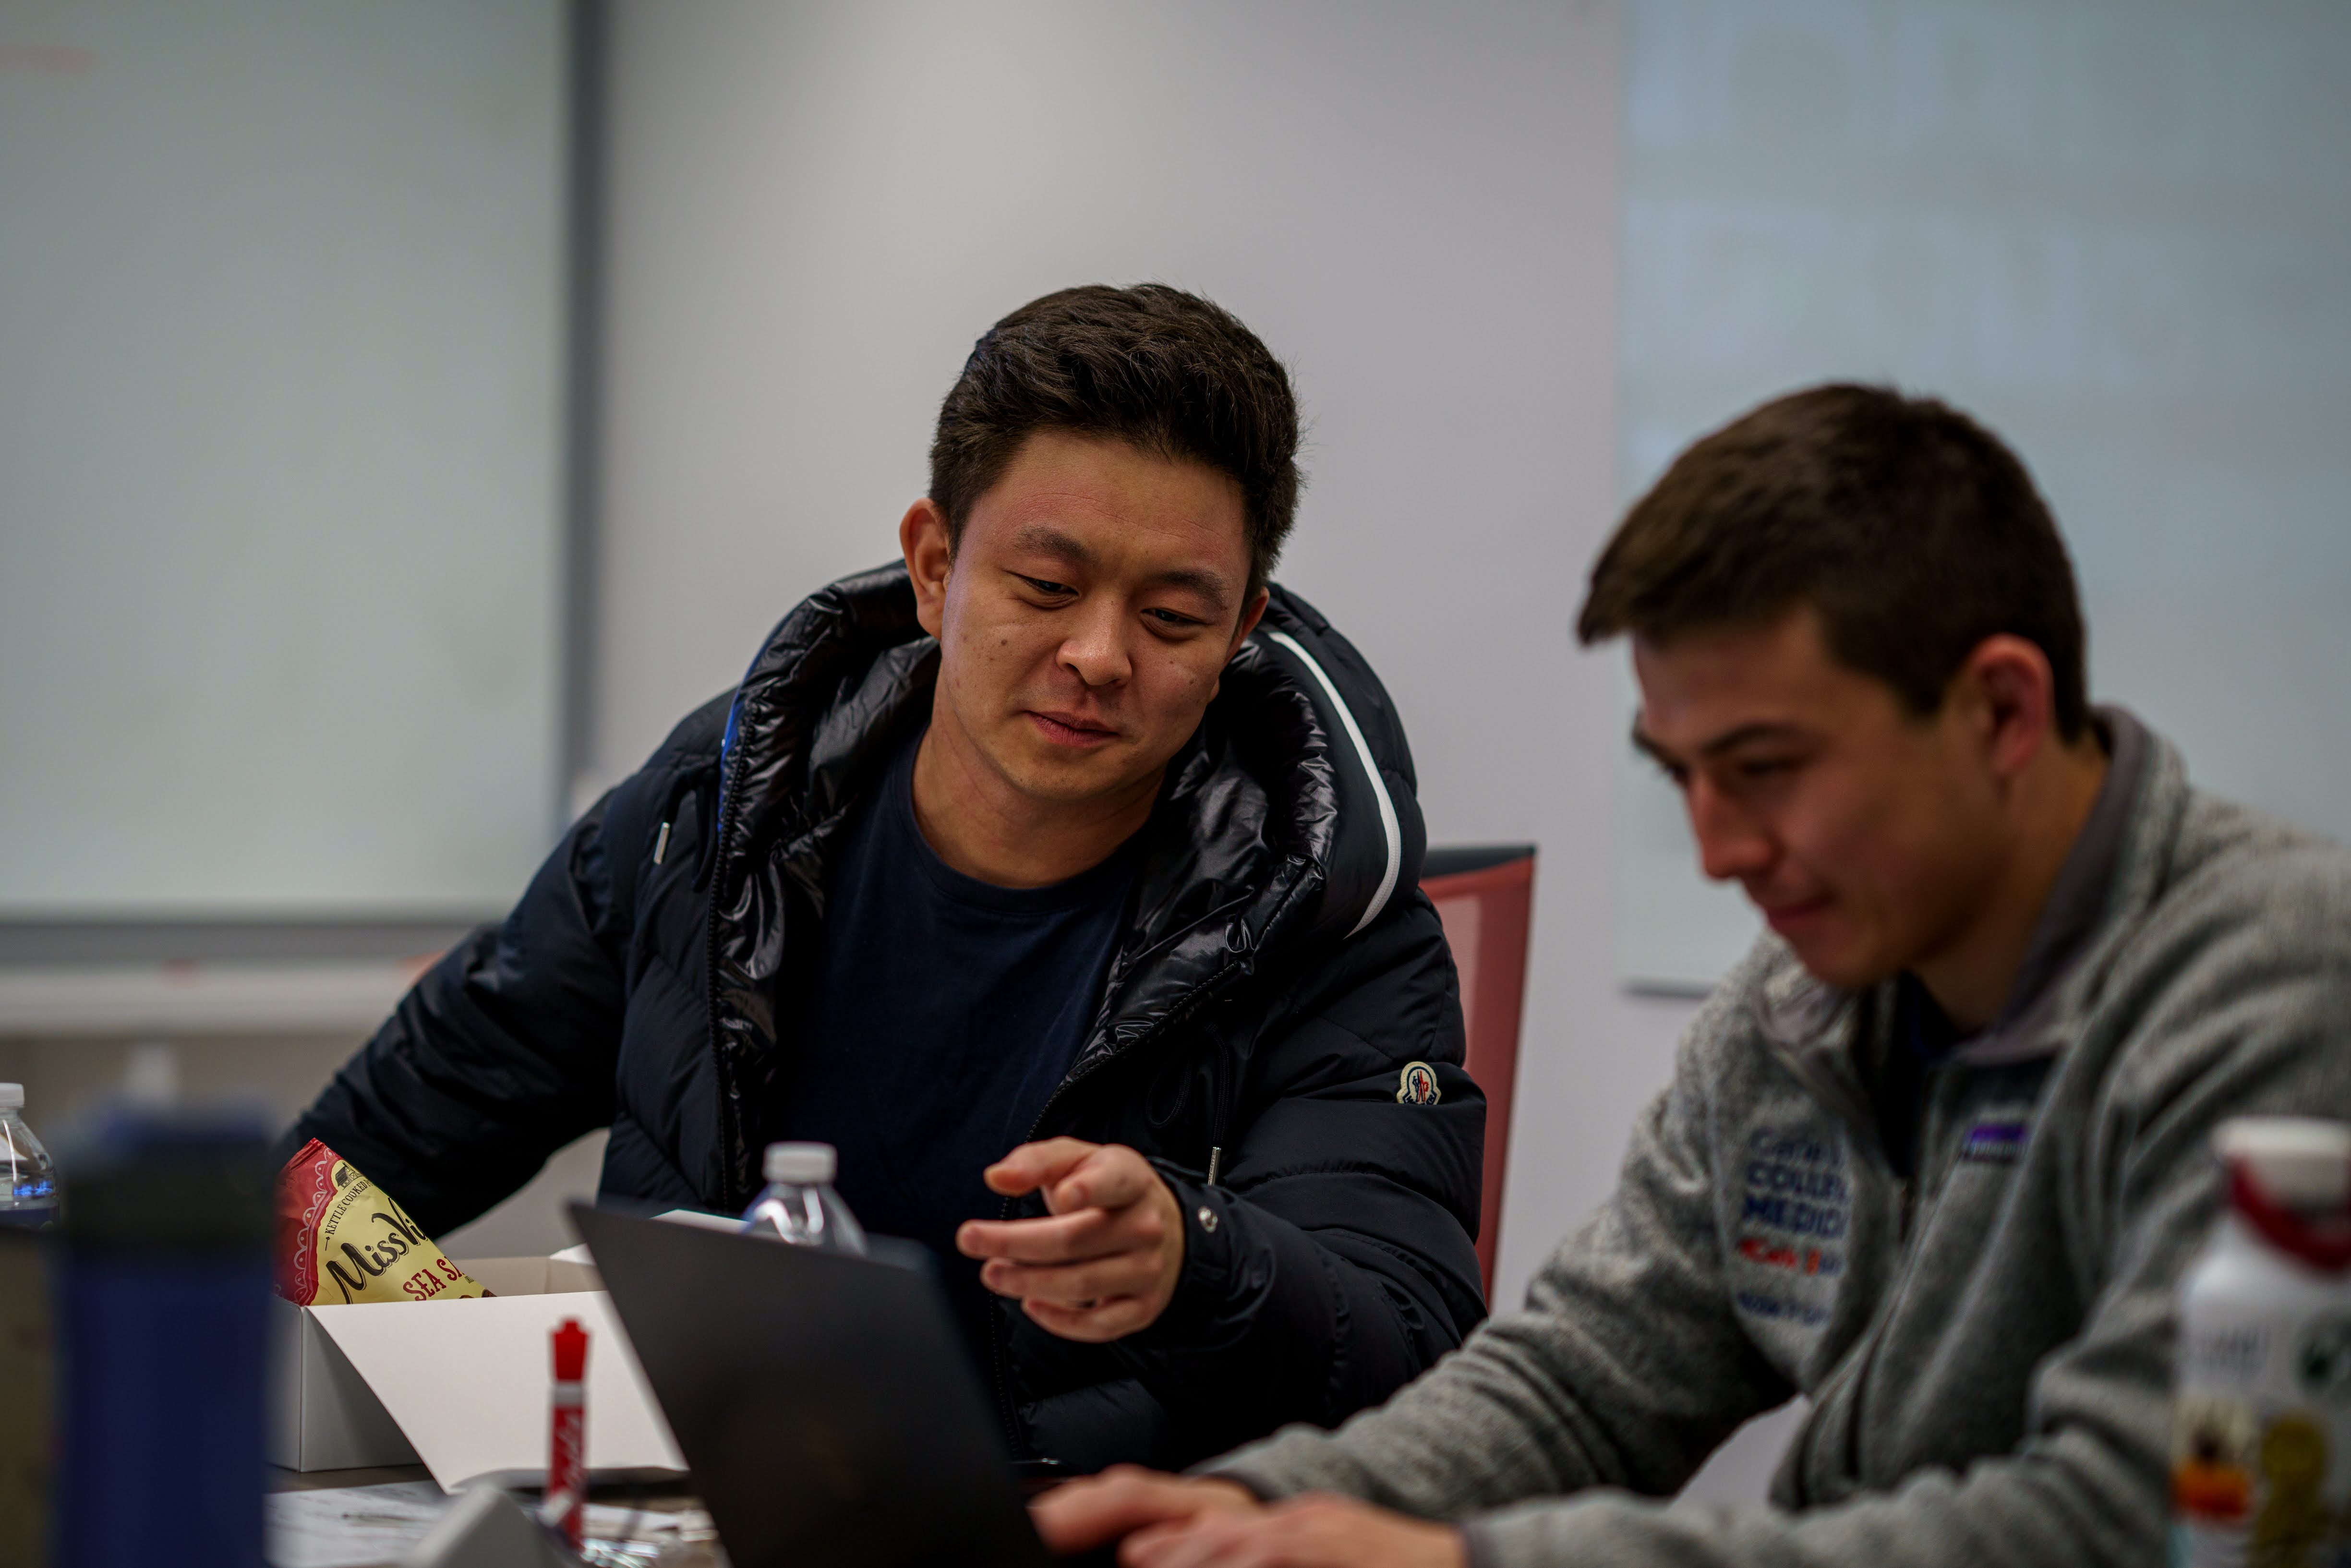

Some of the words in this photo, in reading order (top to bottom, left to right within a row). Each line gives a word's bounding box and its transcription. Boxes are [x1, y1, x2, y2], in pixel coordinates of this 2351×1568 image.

[325, 1203, 346, 1235] KETTLE
[342, 1182, 368, 1206] COOKED
[326, 1232, 410, 1305] Miss
[371, 1197, 428, 1246] Vi
[403, 1269, 446, 1302] SEA
